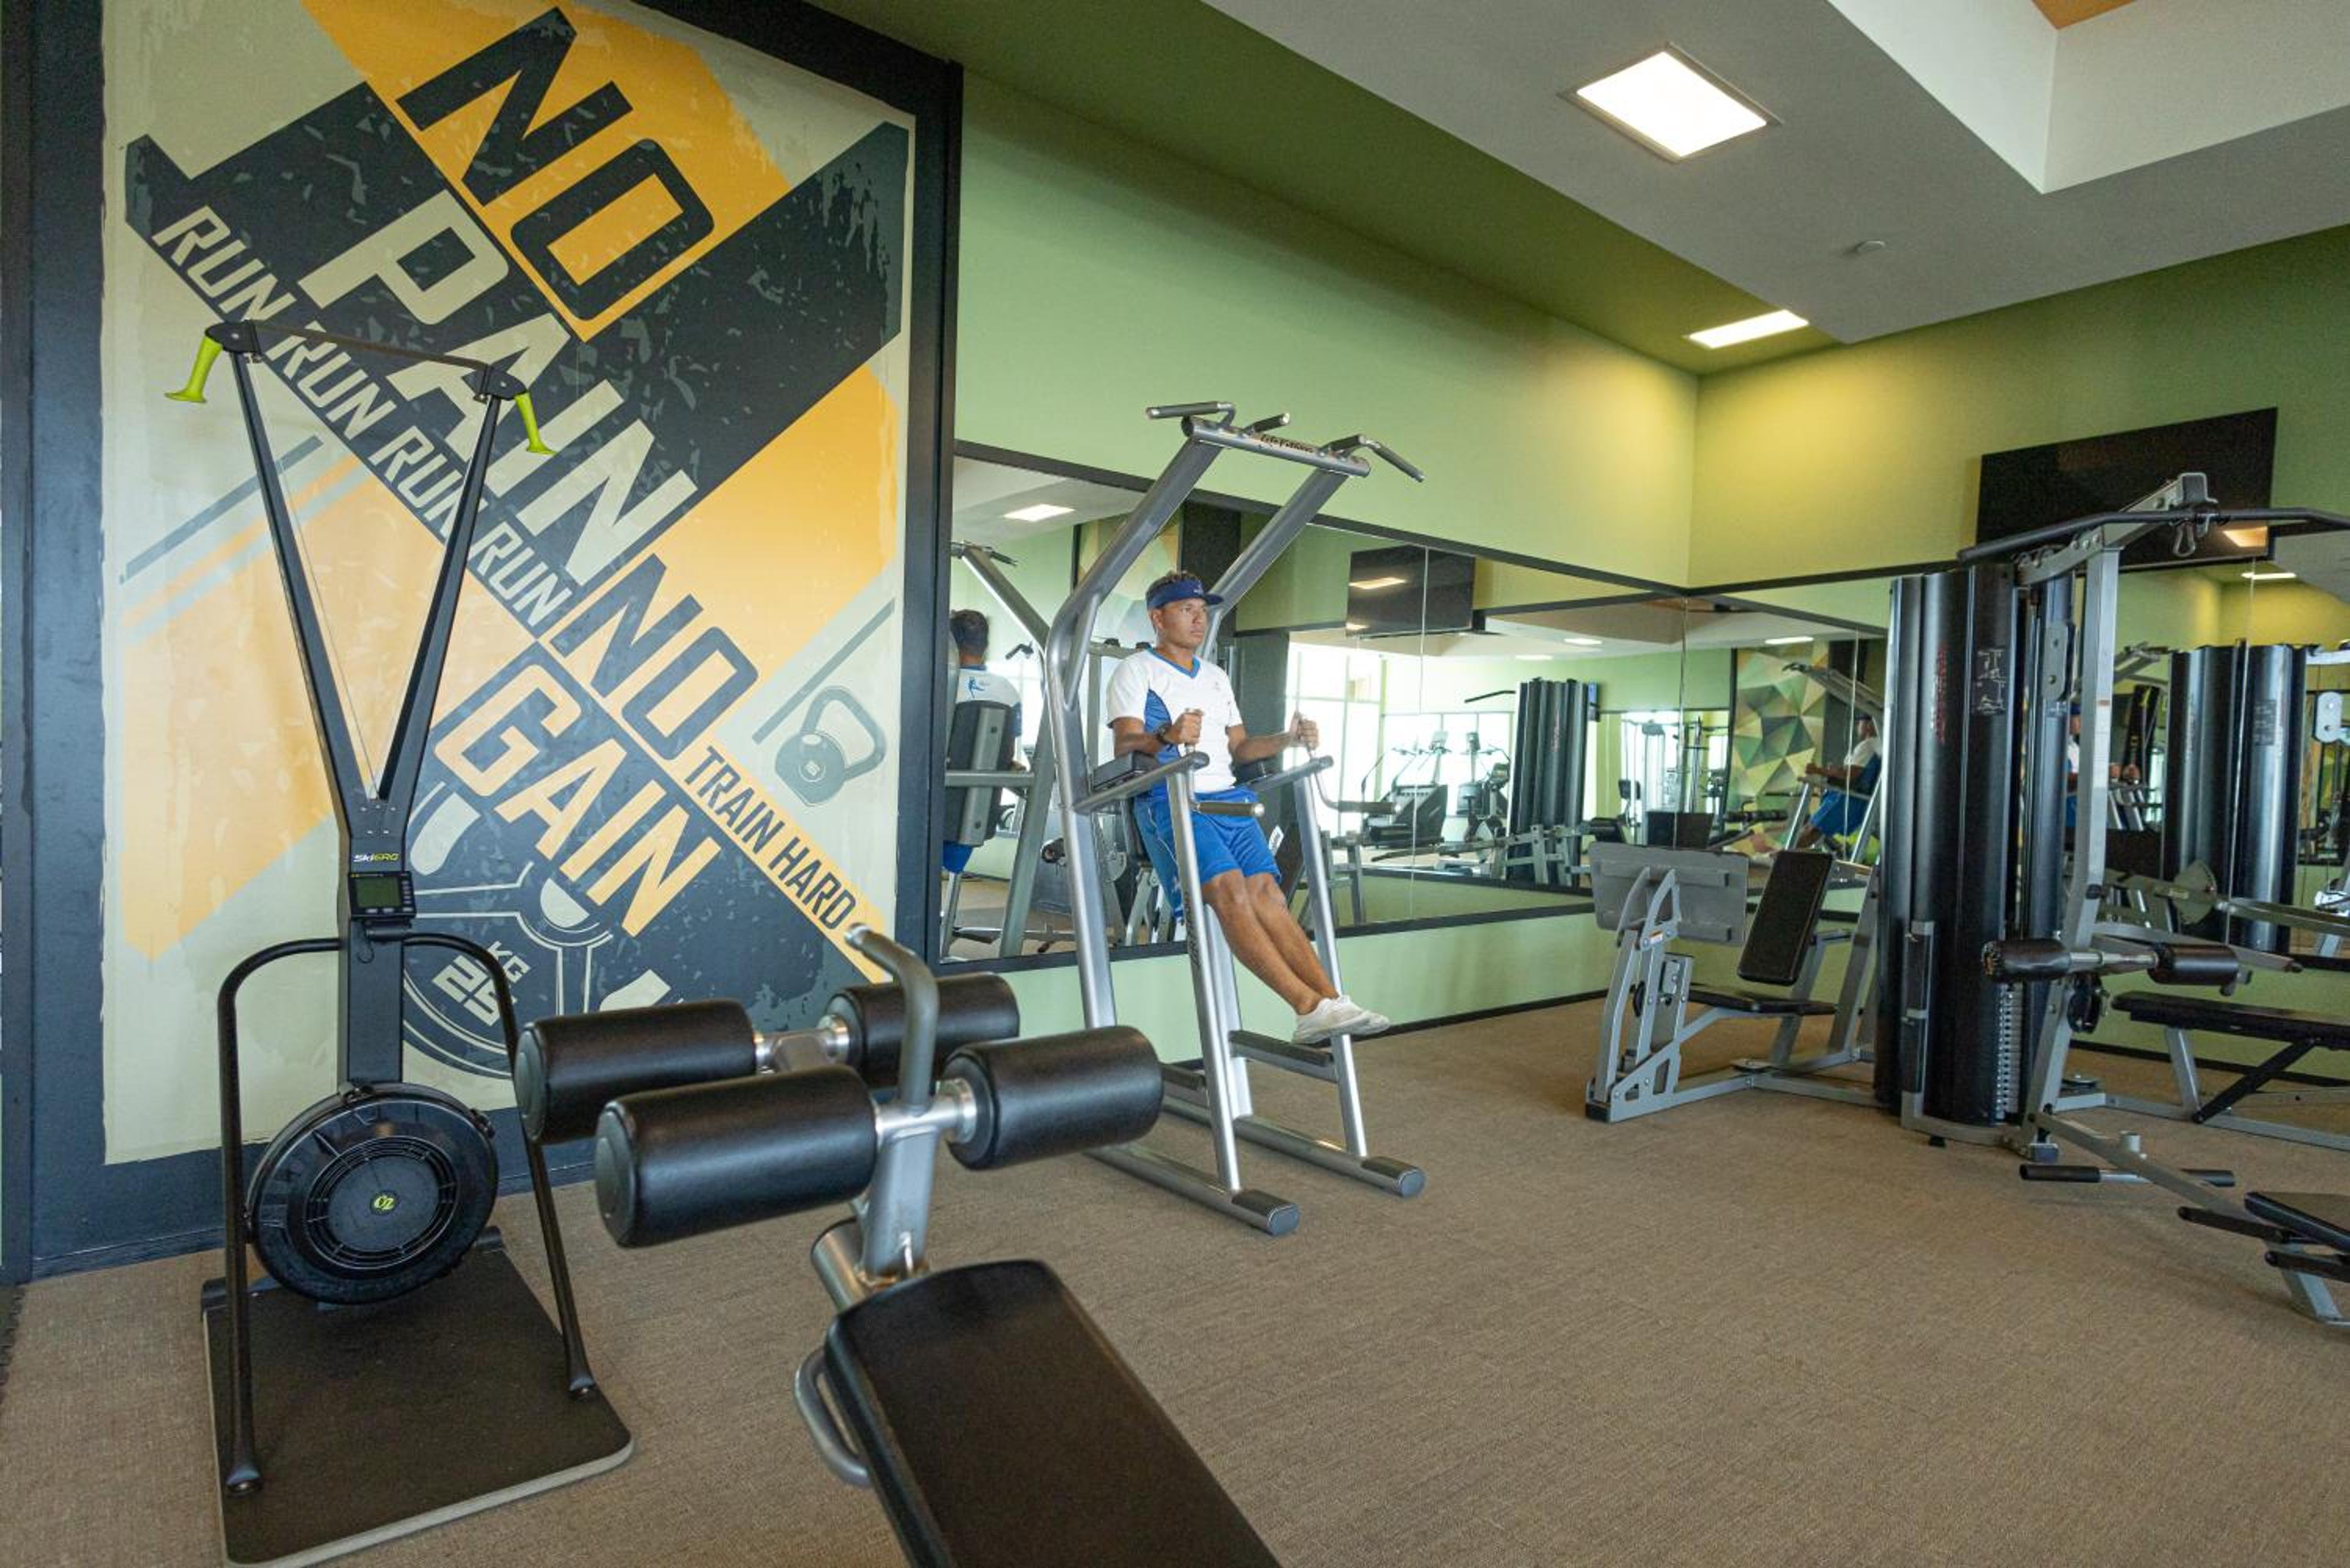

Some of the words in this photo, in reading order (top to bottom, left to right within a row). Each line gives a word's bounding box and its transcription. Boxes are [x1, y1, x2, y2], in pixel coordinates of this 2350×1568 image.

[395, 7, 715, 321] NO
[150, 204, 297, 321] RUN
[265, 320, 397, 440] RUN
[467, 522, 572, 627] RUN
[297, 189, 698, 586] PAIN
[549, 553, 758, 761] NO
[434, 664, 721, 937] GAIN
[685, 746, 785, 854] TRAIN
[768, 836, 856, 929] HARD
[487, 941, 531, 983] KG
